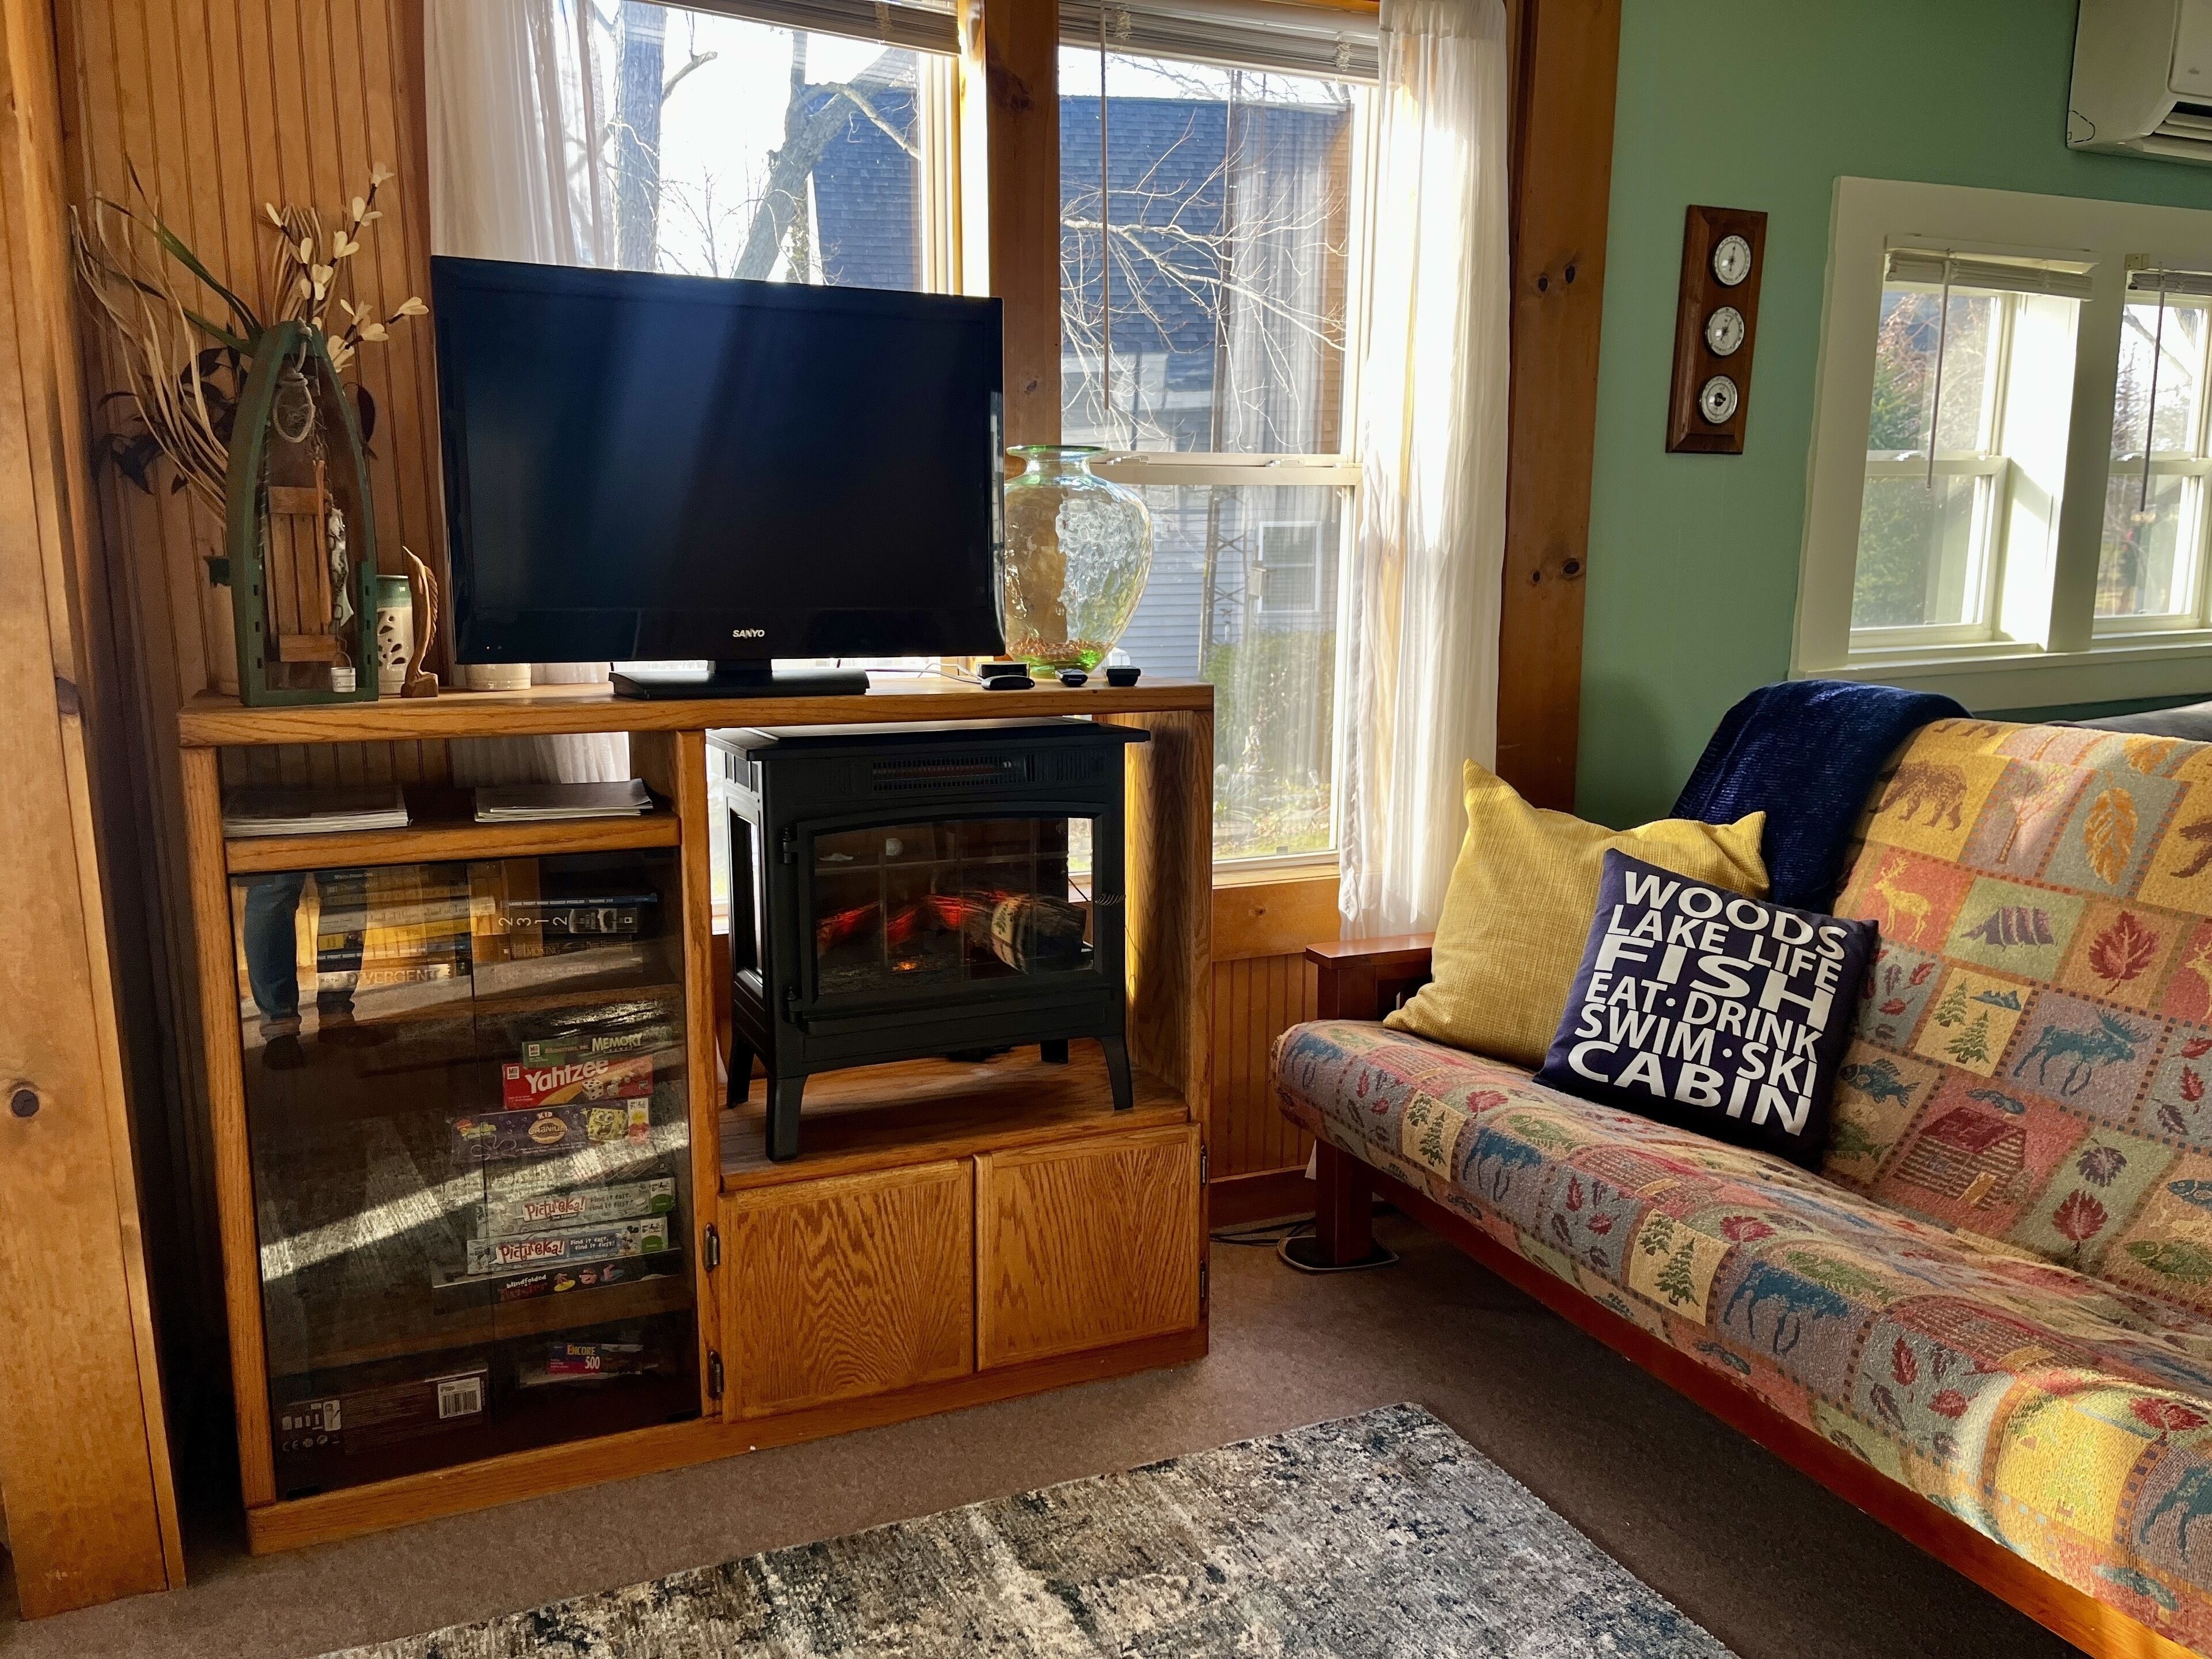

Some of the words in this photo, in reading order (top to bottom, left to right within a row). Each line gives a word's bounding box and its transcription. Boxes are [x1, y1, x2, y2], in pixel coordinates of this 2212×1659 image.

[733, 629, 765, 638] SANYO
[1624, 871, 1847, 960] WOODS
[1607, 904, 1729, 955] LAKE
[1748, 934, 1842, 994] LIFE
[1594, 933, 1834, 1031] FISH
[592, 1033, 643, 1052] MEMORY
[1574, 1003, 1715, 1066] SWIM
[1736, 1043, 1817, 1097] SKI
[525, 1060, 609, 1094] Yahtzee
[1568, 1040, 1812, 1137] CABIN
[537, 1111, 553, 1120] KID
[506, 1274, 547, 1289] blindfolded
[567, 1344, 596, 1355] ENCORE
[585, 1356, 600, 1369] 500
